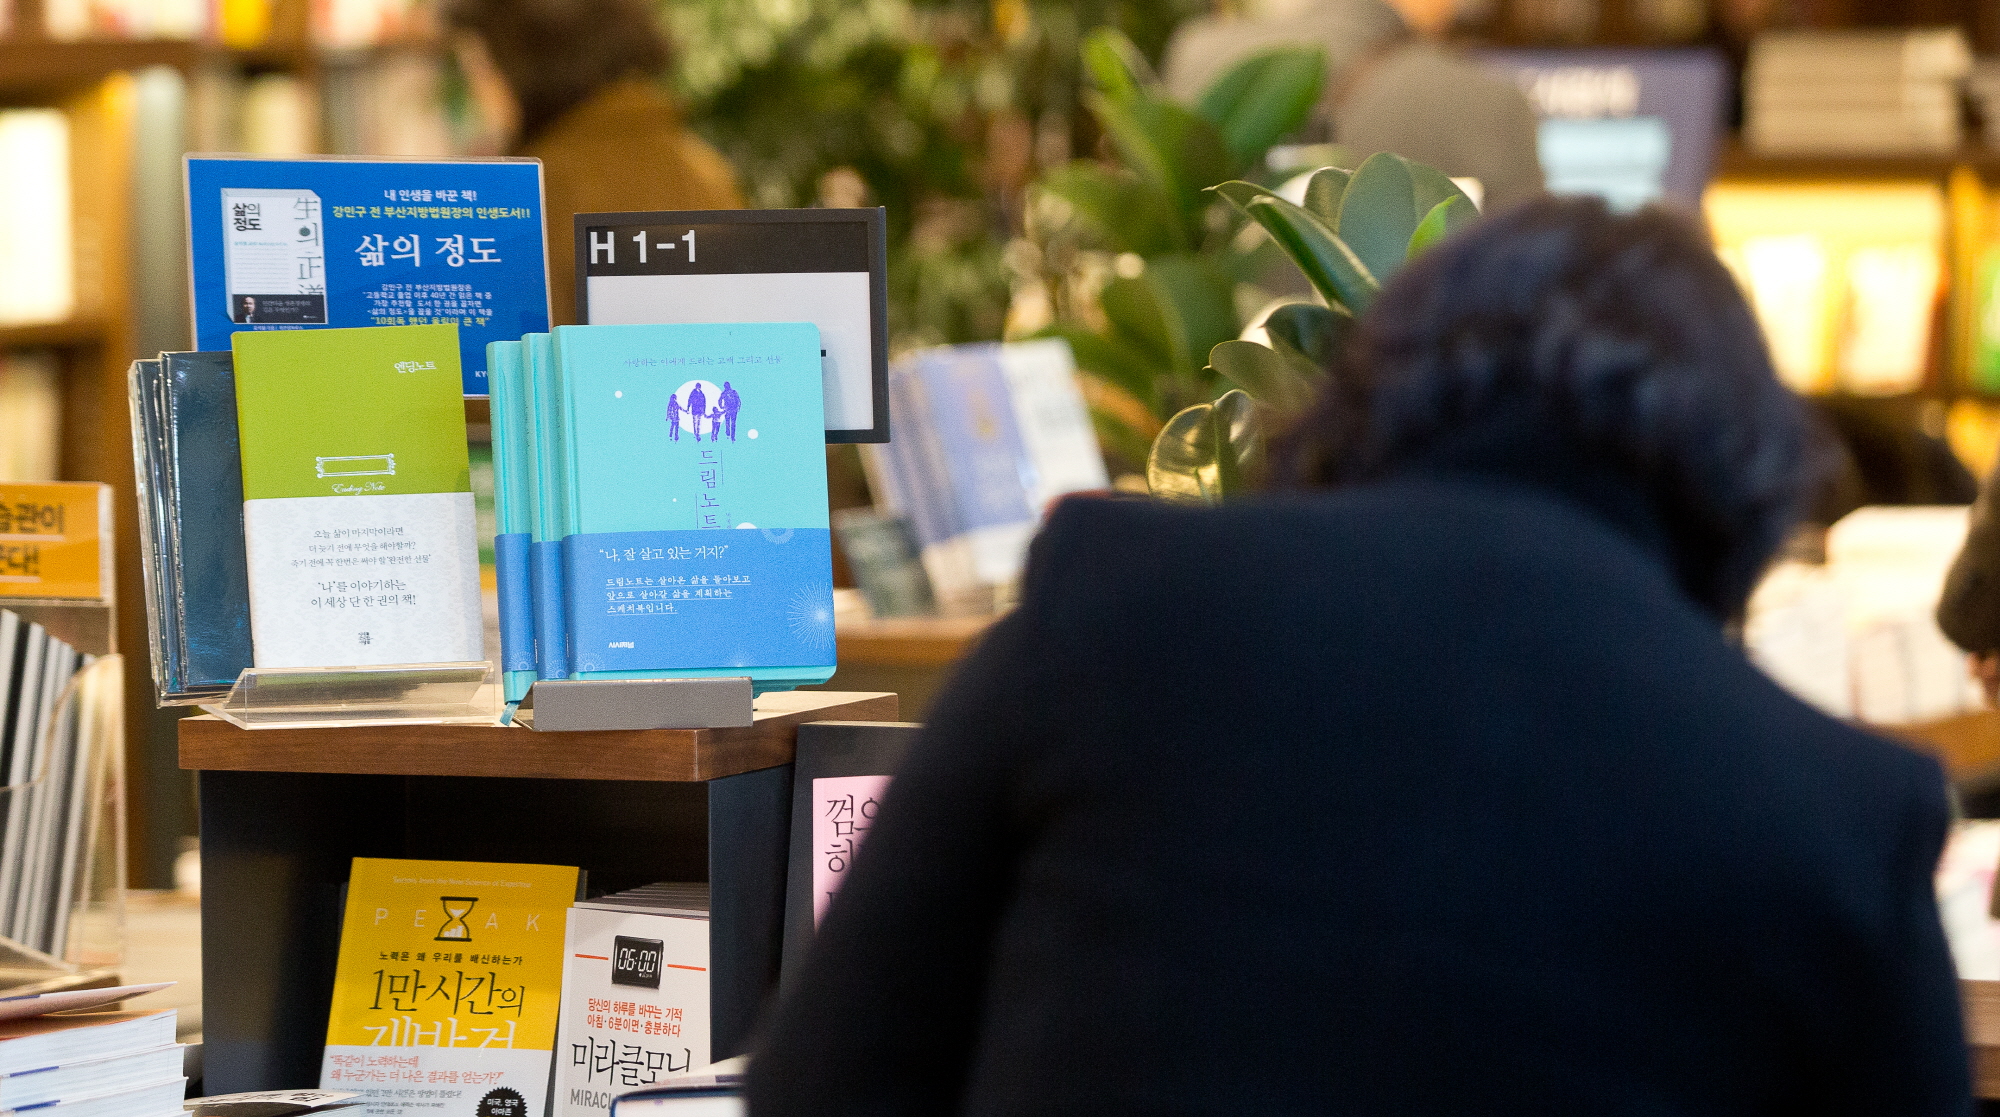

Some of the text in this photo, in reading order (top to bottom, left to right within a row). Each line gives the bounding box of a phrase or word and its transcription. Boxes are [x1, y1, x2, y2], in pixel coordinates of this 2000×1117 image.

[384, 190, 478, 202] 내 인생을 바꾼 책!
[233, 203, 260, 217] 삶의
[332, 206, 531, 220] 강민구 전 부산지방법원장의 인생도서!!
[234, 218, 262, 232] 정도
[355, 233, 502, 268] 삶의 정도
[590, 229, 696, 264] H 1-1
[394, 361, 437, 374] 엔딩노트
[699, 450, 721, 529] 드림노트
[313, 527, 404, 539] 오늘 삶이 마지막이라면
[308, 545, 317, 553] 더
[318, 544, 335, 553] 늦기
[337, 543, 352, 553] 전에
[354, 543, 378, 552] 무엇을
[623, 547, 637, 561] 잘
[639, 547, 665, 561] 살고
[667, 546, 692, 561] 있는
[694, 545, 729, 560] 거지?"
[350, 579, 406, 592] 이야기하는
[605, 574, 751, 587] 드림노트는 살아온 삶을 돌아보고
[311, 594, 416, 609] 이 세상 단 한 권의 책!
[606, 588, 733, 601] 앞으로 살아갈 삶을 계획하는
[606, 602, 678, 614] 스케치북입니다.
[379, 951, 523, 966] 노력은 왜 우리를 배신하는가
[618, 948, 657, 973] 06:00
[368, 969, 526, 1018] 1만 시간의
[588, 998, 683, 1022] 당신의 하루를 바꾸는 기적
[367, 1055, 420, 1069] 노력하는데
[330, 1069, 342, 1082] 왜
[343, 1069, 388, 1083] 누군가는
[389, 1069, 400, 1083] 더
[402, 1070, 425, 1083] 나은
[427, 1070, 460, 1084] 결과를
[570, 1089, 614, 1111] MIRACL
